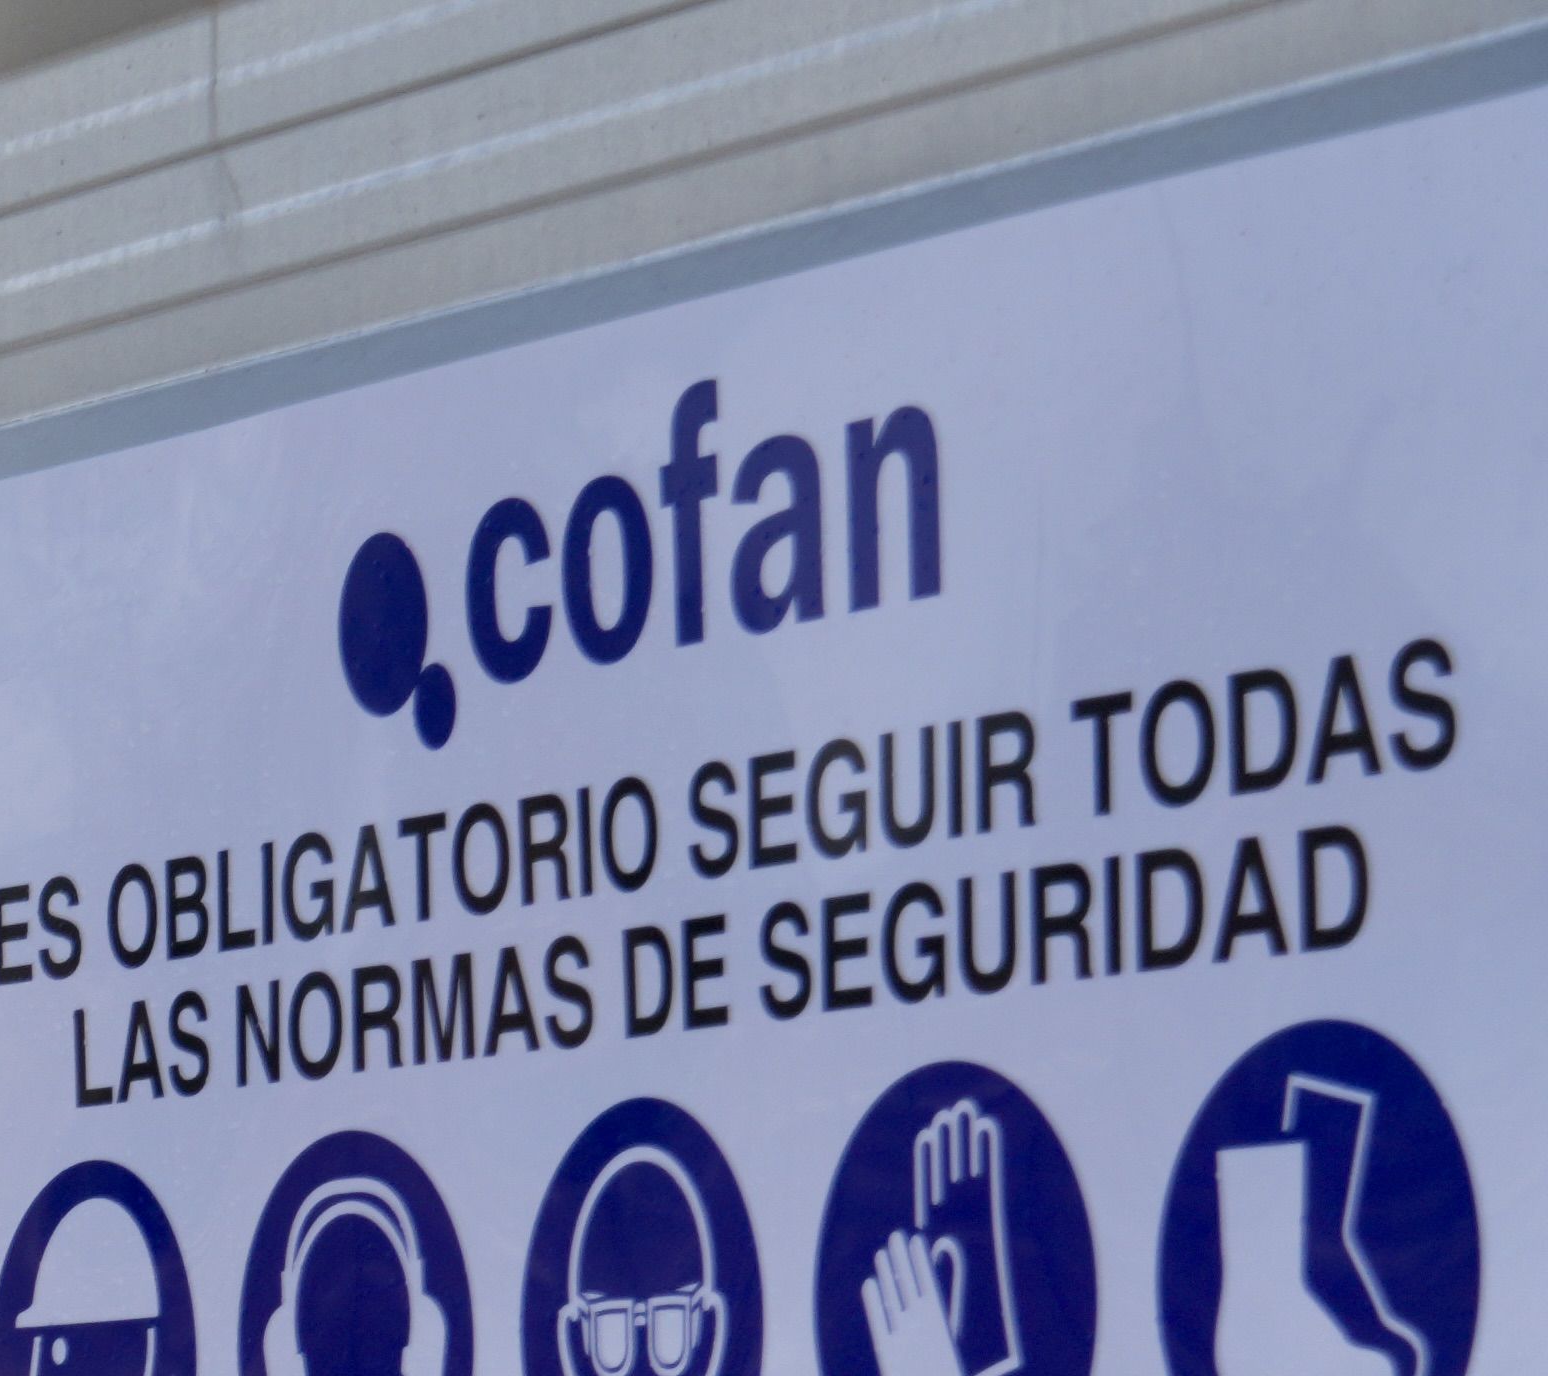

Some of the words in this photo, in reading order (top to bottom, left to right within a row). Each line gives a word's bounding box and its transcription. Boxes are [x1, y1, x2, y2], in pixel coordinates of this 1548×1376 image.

[464, 379, 942, 685] cofan
[107, 776, 658, 970] OBLIGATORIO
[687, 709, 1037, 880] SEGUIR
[1070, 637, 1458, 818] TODAS
[73, 990, 212, 1108] LAS
[235, 935, 596, 1088] NORMAS
[622, 913, 731, 1040] DE
[758, 824, 1370, 1021] SEGURIDAD
